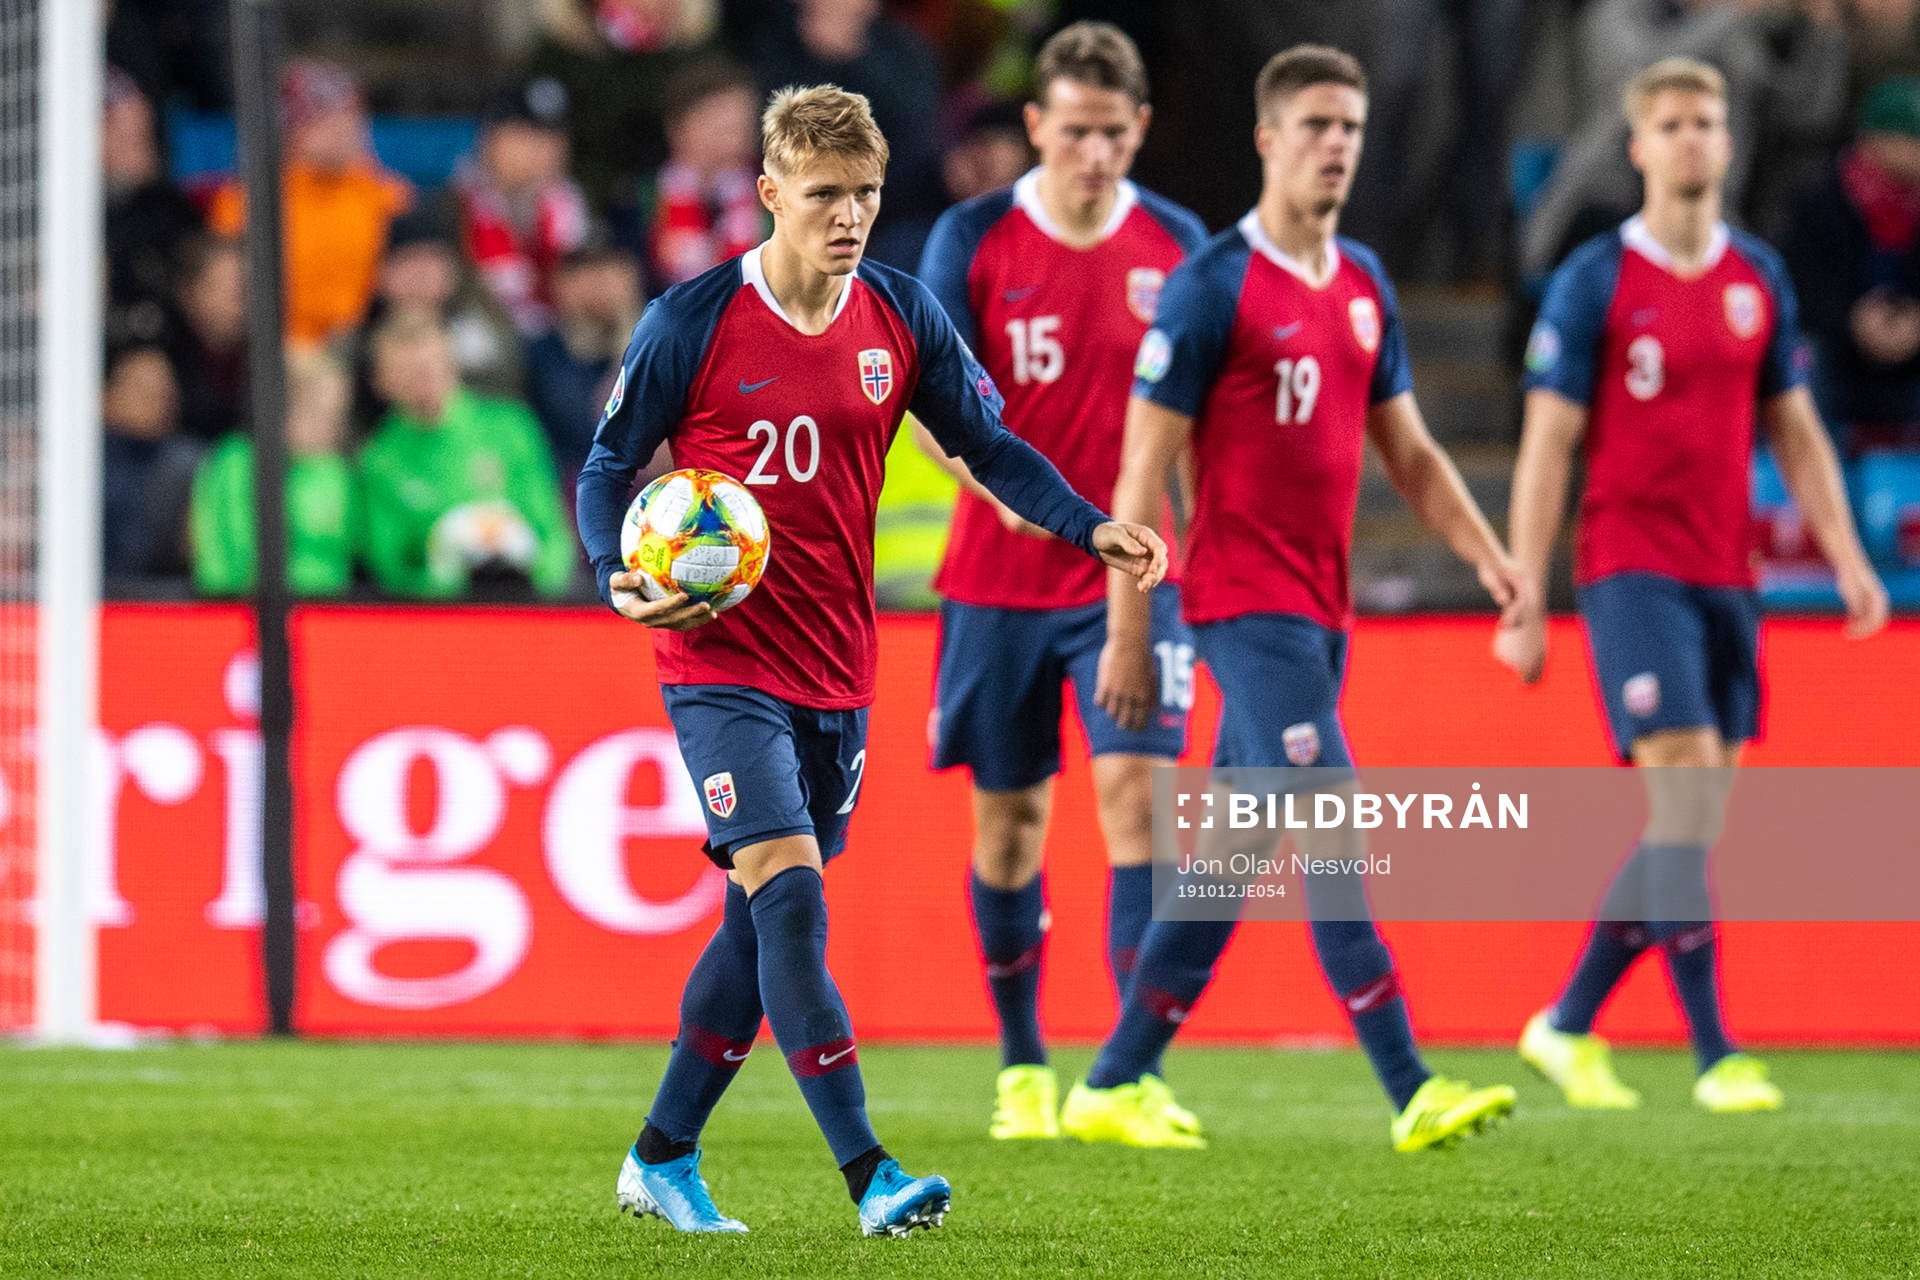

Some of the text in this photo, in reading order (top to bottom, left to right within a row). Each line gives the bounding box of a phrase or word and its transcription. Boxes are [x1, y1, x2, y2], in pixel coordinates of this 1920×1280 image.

[1006, 314, 1065, 386] 15
[1624, 334, 1666, 402] 3
[1273, 354, 1321, 426] 19
[744, 415, 820, 485] 20
[1154, 641, 1196, 711] 15
[0, 650, 728, 1009] rige
